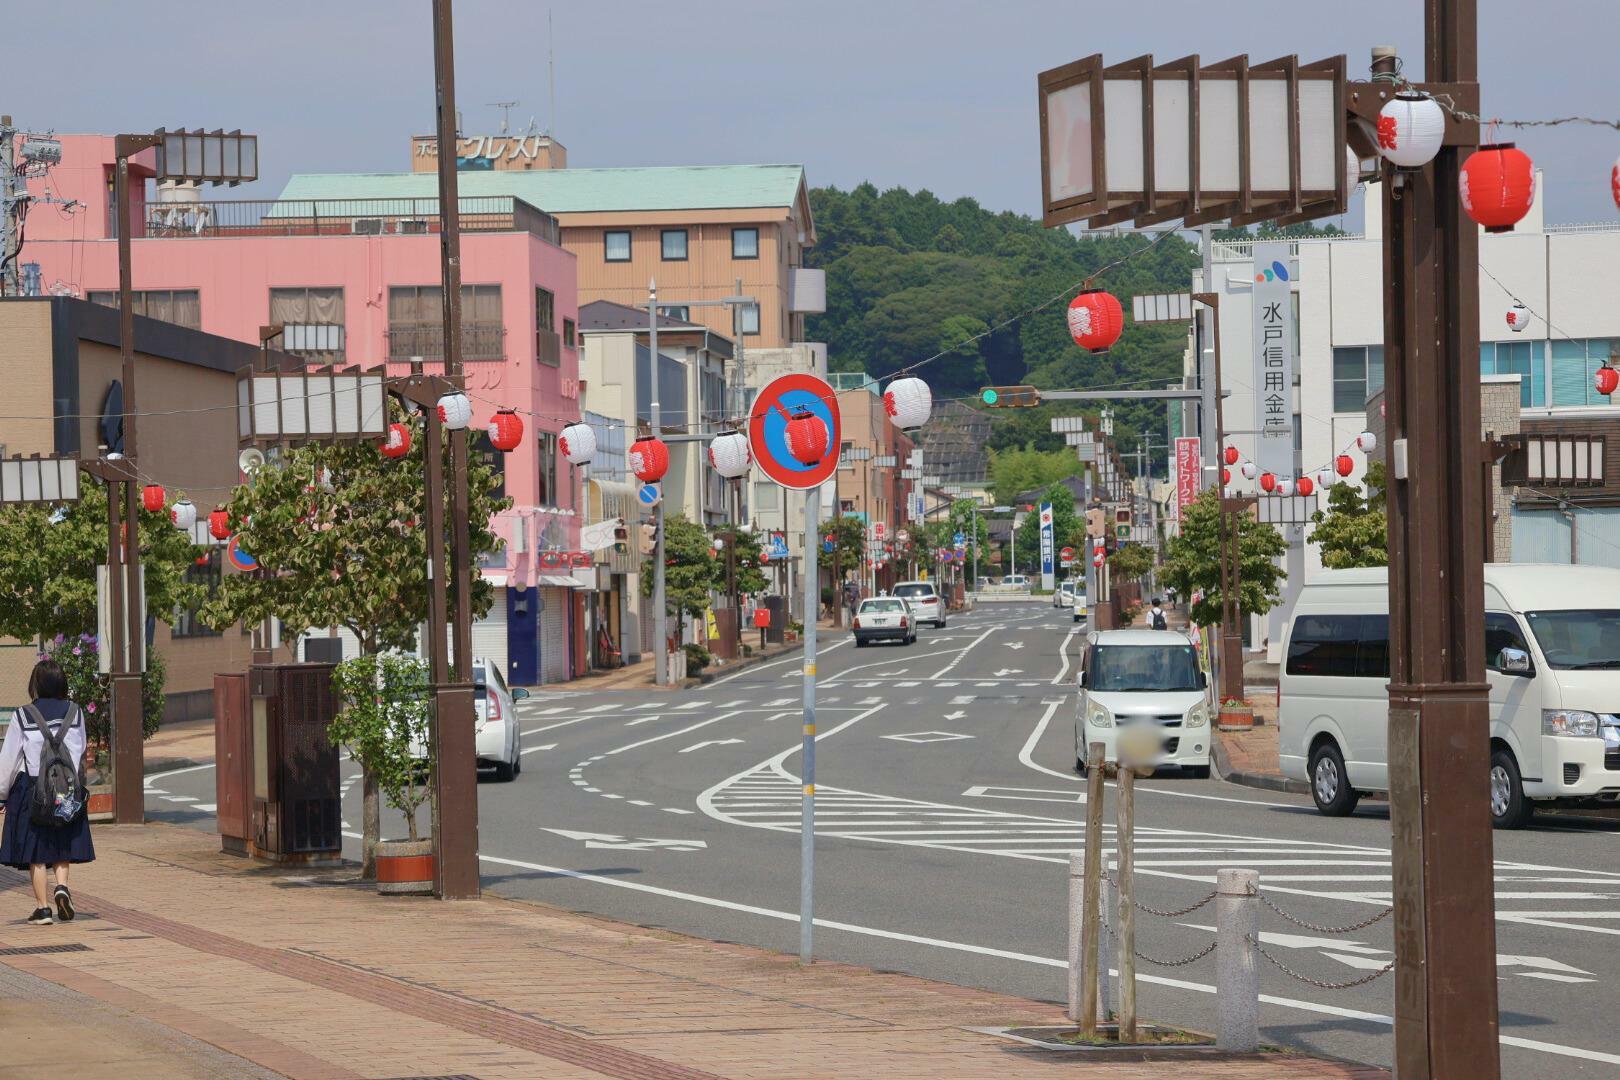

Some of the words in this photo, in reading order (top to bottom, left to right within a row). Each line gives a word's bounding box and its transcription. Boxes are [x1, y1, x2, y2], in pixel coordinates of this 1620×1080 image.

[417, 136, 550, 160] ホクレスト
[1179, 439, 1191, 523] ライトワークエ
